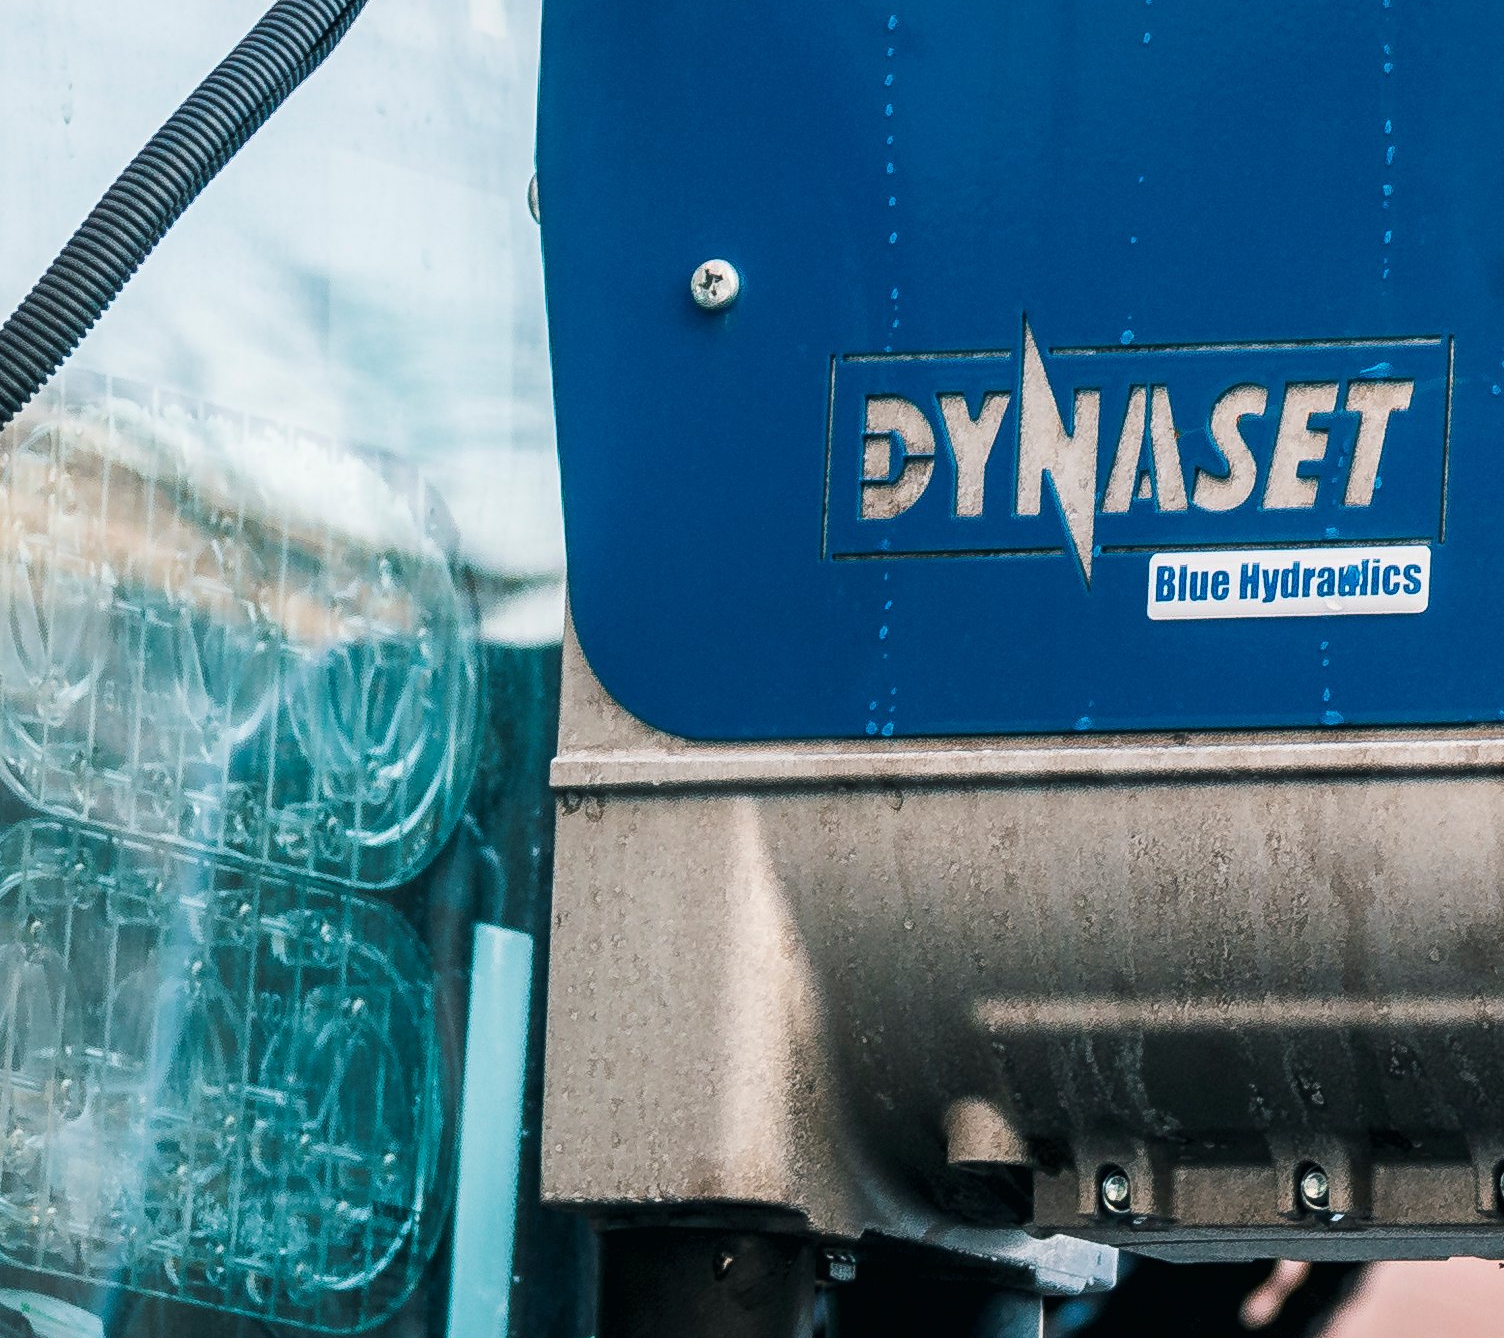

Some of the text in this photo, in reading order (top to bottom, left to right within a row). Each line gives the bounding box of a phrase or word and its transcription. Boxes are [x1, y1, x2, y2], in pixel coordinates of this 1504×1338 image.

[858, 311, 1415, 591] DYNASET
[1155, 559, 1422, 603] Blue Hydraulics
